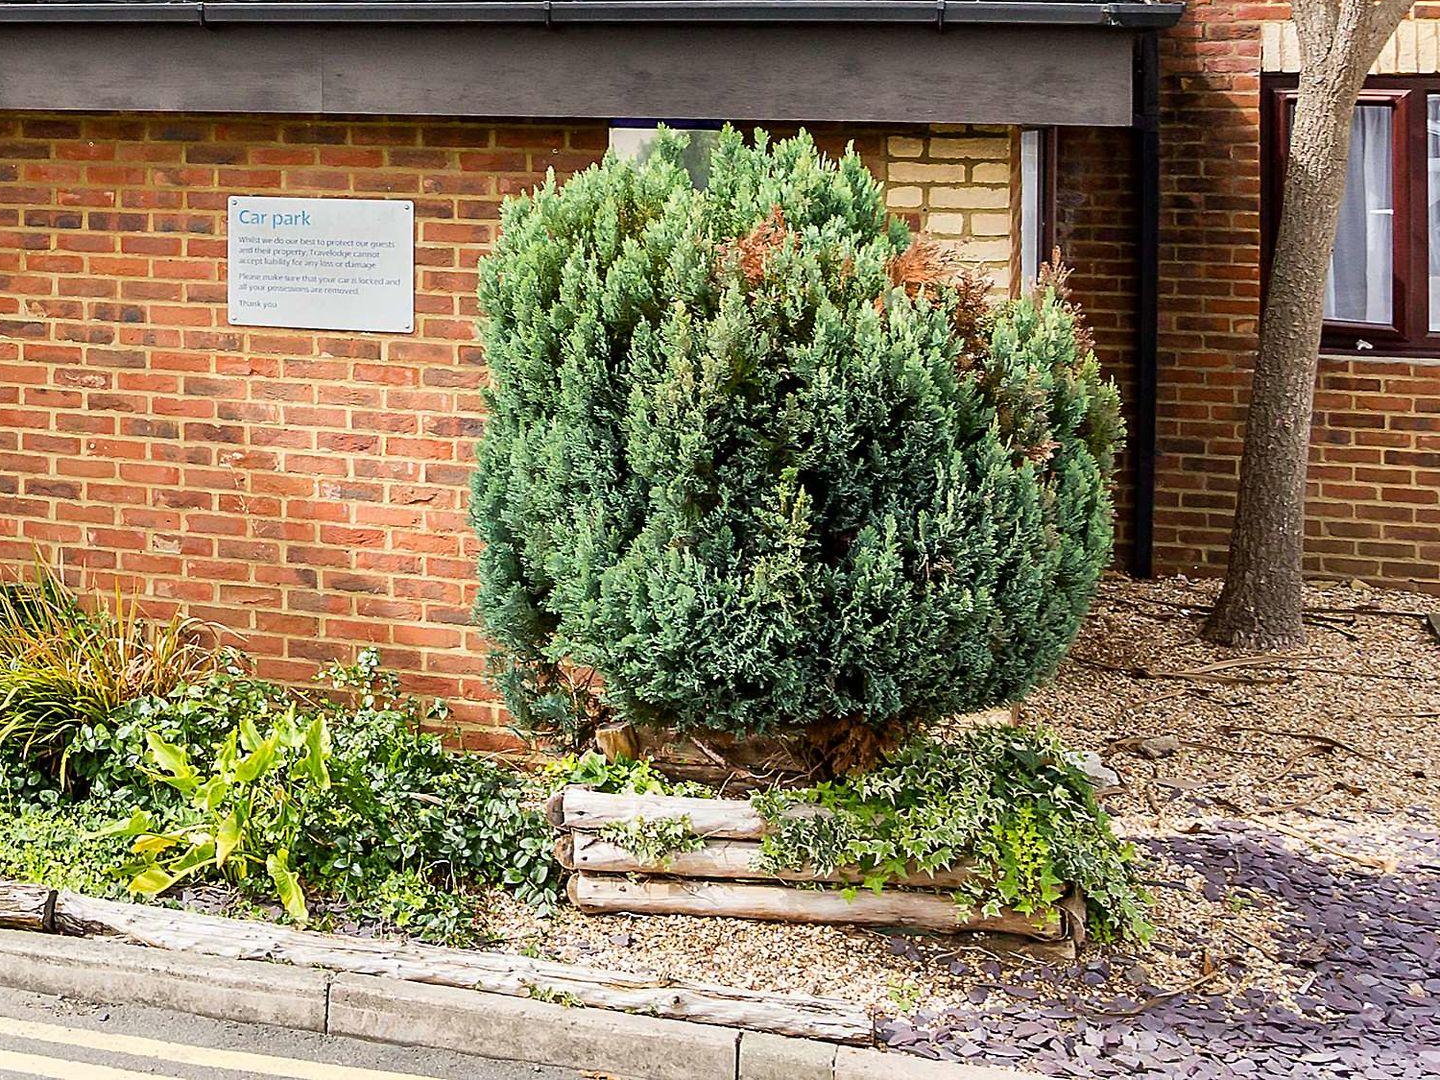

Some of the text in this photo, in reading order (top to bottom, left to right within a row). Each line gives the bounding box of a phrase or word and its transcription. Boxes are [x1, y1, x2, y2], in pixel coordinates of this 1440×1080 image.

[239, 209, 311, 229] Car park
[326, 239, 354, 247] protect
[310, 248, 352, 258] Travelodge
[262, 273, 283, 281] make
[319, 276, 336, 284] your
[359, 277, 384, 285] locked
[239, 300, 261, 308] Thank
